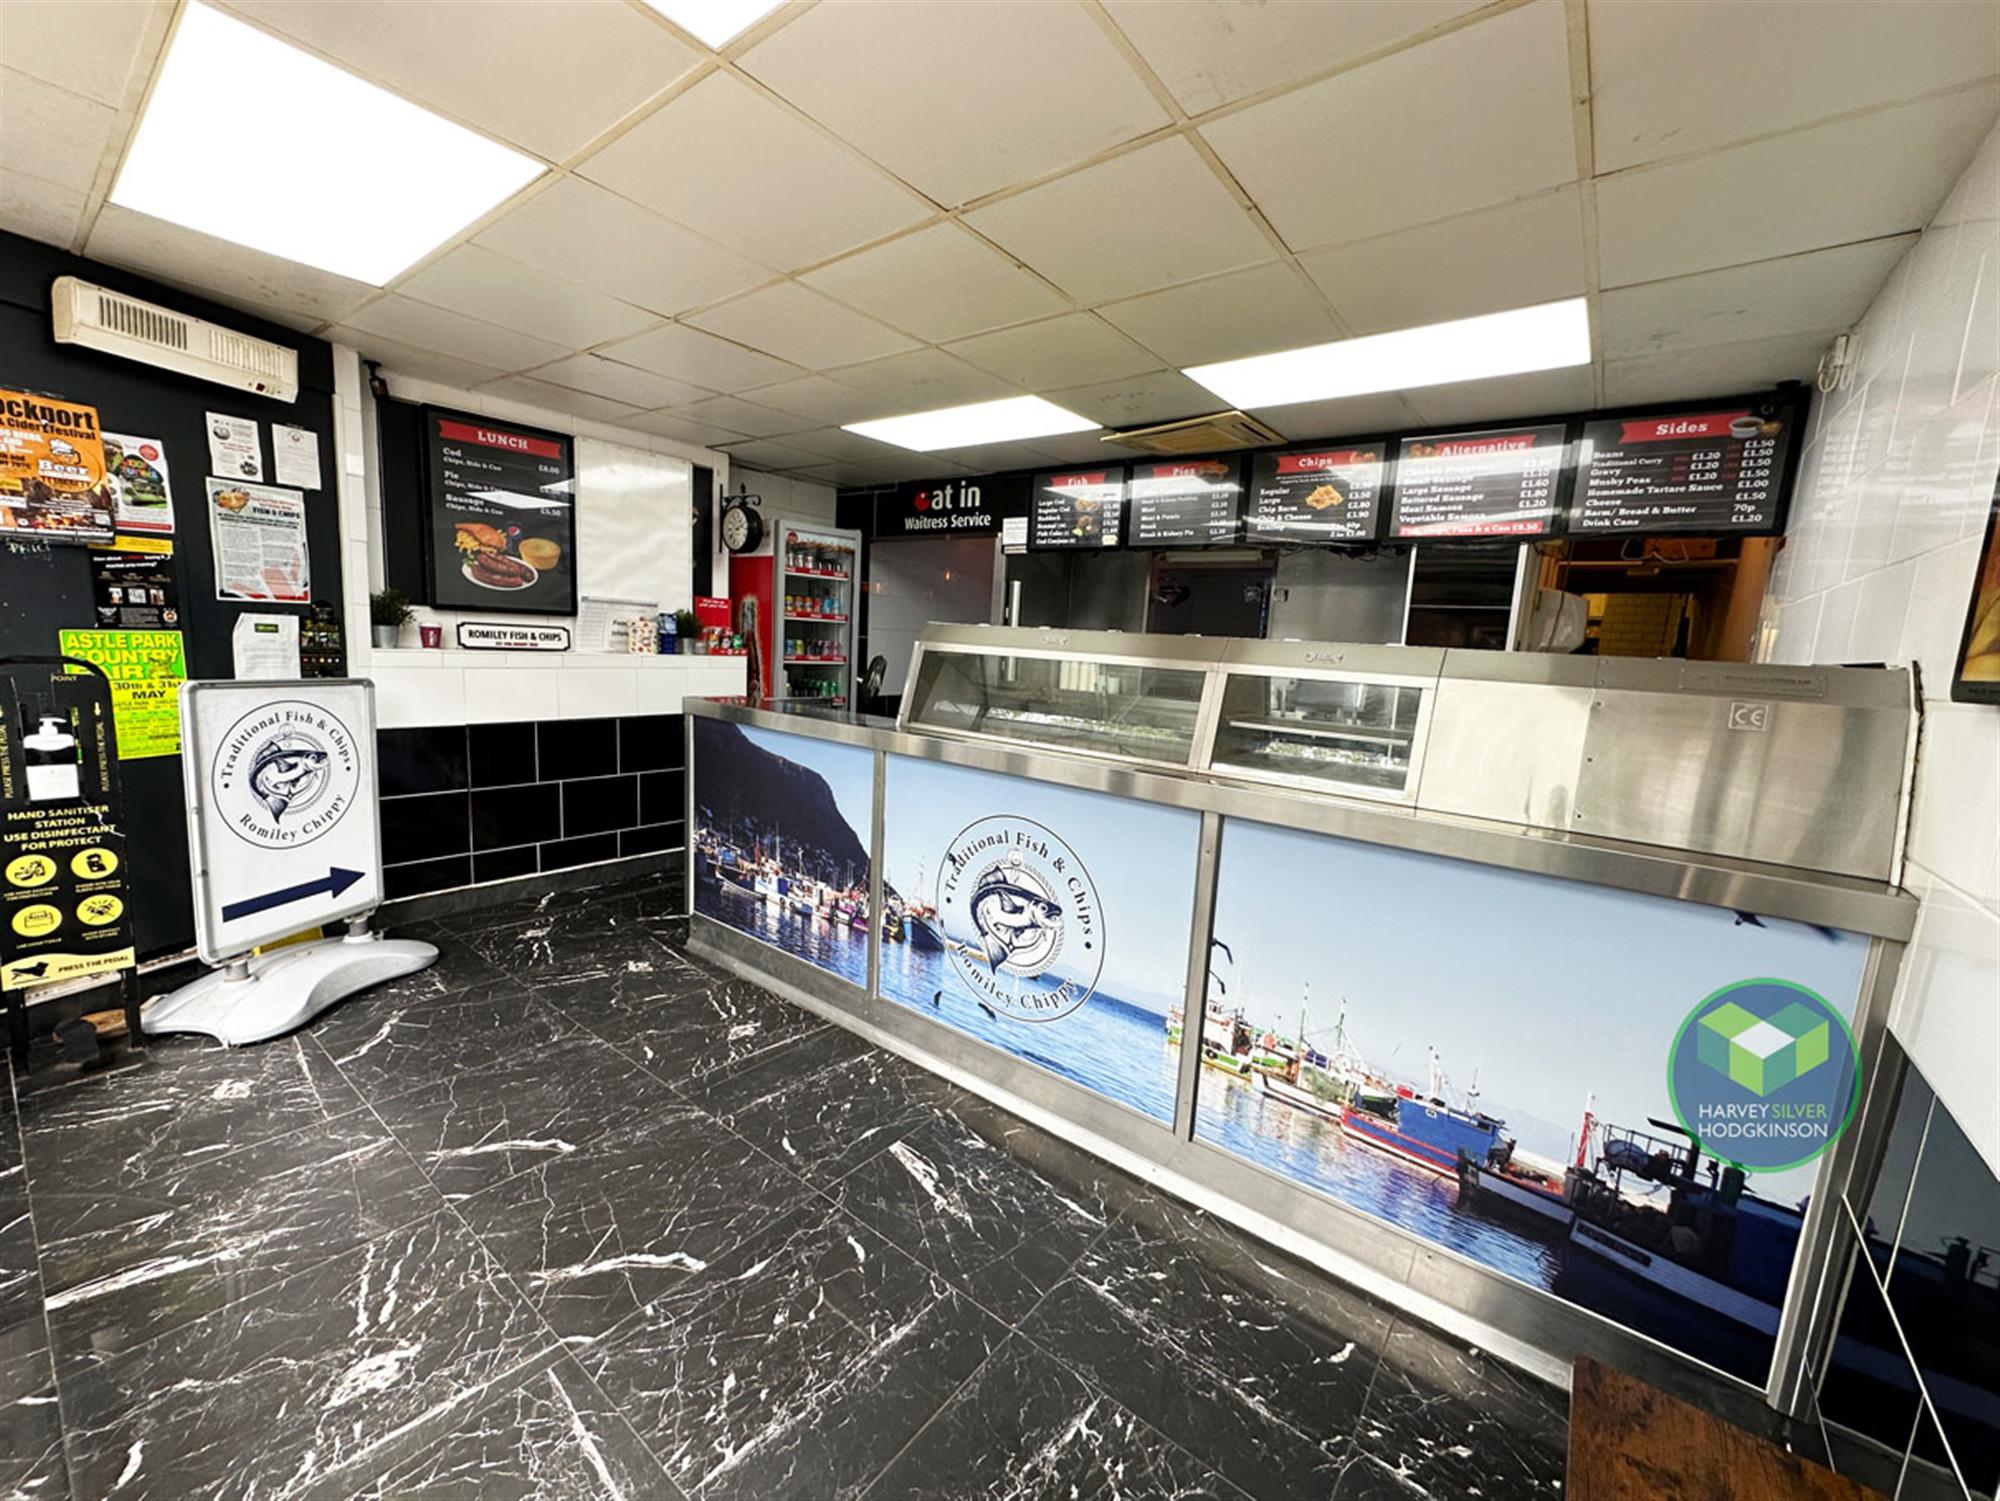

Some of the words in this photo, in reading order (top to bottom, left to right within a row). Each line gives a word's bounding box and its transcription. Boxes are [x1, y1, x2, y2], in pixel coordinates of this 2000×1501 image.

[1656, 422, 1709, 436] Sides
[477, 430, 528, 449] LUNCH
[1744, 439, 1775, 448] £1.50
[443, 447, 462, 457] Cod
[1441, 441, 1527, 456] Alternative
[1298, 457, 1333, 468] Chips
[1638, 457, 1662, 466] Curry
[1692, 452, 1720, 460] £1.20
[1743, 449, 1773, 457] £1.50
[444, 470, 459, 479] Pie
[1590, 468, 1622, 477] Gravy
[1690, 461, 1719, 471] £1.20
[1741, 459, 1771, 467] £1.50
[1589, 478, 1624, 488] Mushy
[1626, 476, 1651, 485] Peas
[1688, 472, 1717, 481] £1.20
[1739, 469, 1770, 478] £1.50
[960, 480, 981, 508] in
[1260, 488, 1290, 496] Regular
[1402, 487, 1428, 496] Large
[1430, 484, 1472, 494] Sausage
[1521, 479, 1550, 488] £1.60
[1587, 487, 1645, 498] Homemade
[1646, 485, 1686, 494] Tartare
[1688, 483, 1723, 492] Sauce
[1737, 480, 1769, 489] £1.00
[1259, 498, 1281, 506] Large
[1442, 493, 1484, 503] Sausage
[1519, 489, 1548, 499] £1.80
[1585, 498, 1622, 507] Cheese
[1735, 492, 1766, 501] £1.50
[1258, 506, 1276, 514] Chip
[1400, 505, 1424, 514] Meat
[1425, 504, 1463, 512] Samosa
[1518, 499, 1546, 509] £1.20
[1619, 507, 1649, 516] Bread
[1651, 507, 1660, 515] &
[1662, 505, 1697, 514] Butter
[1733, 503, 1756, 514] 70p
[904, 515, 948, 530] Waitress
[950, 512, 991, 528] Service
[1582, 518, 1611, 527] Drink
[1613, 517, 1640, 526] Cans
[1731, 514, 1763, 523] £1.20
[67, 634, 127, 648] ASTLE
[131, 634, 178, 649] PARK
[468, 629, 508, 640] ROMILEY
[509, 631, 528, 640] FISH
[530, 632, 537, 641] &
[538, 632, 562, 642] CHIPS
[69, 649, 178, 663] COUNTRY
[52, 674, 78, 682] POINT
[114, 682, 143, 690] 30th
[132, 691, 166, 700] MAY
[221, 712, 281, 779] Traditional
[285, 711, 314, 724] Fish
[316, 719, 327, 730] &
[329, 728, 350, 764] Chips
[7, 810, 46, 820] HAND
[47, 804, 110, 818] SANITISER
[240, 813, 297, 842] Romiley
[302, 794, 347, 834] Chippy
[35, 817, 86, 829] STATION
[3, 832, 29, 842] USE
[30, 824, 116, 840] DISINFECTANT
[21, 841, 47, 851] FOR
[48, 836, 102, 848] PROTECT
[945, 829, 1009, 892] Traditional
[1016, 832, 1049, 859] Fish
[1053, 856, 1066, 873] &
[1067, 876, 1093, 936] Chips
[58, 963, 84, 973] PRESS
[86, 959, 101, 969] THE
[103, 955, 129, 965] PEDAL
[957, 942, 1012, 1008] Romiley
[1020, 977, 1079, 1010] Chippy
